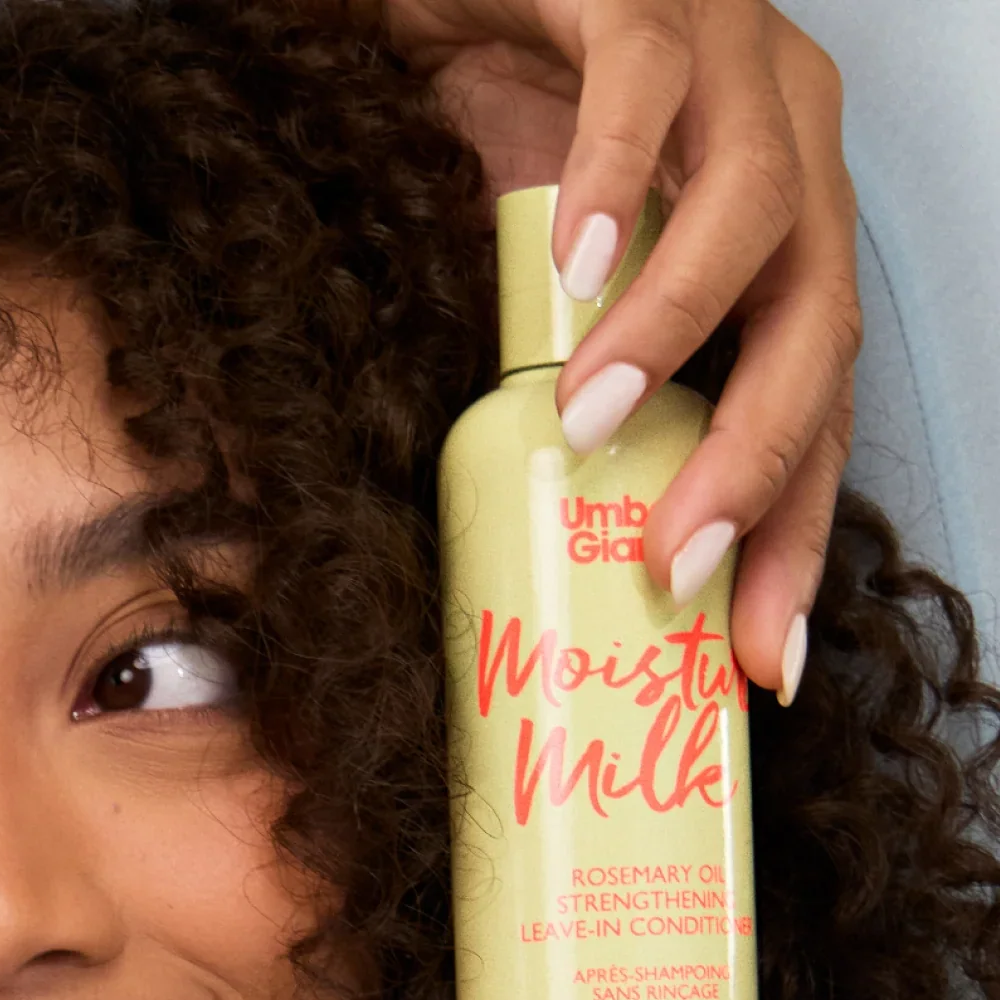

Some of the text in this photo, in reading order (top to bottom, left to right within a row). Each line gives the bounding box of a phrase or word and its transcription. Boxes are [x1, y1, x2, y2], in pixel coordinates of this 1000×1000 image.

[559, 494, 658, 530] Umb
[566, 530, 645, 565] Gia
[477, 609, 750, 718] Moistur
[513, 694, 738, 827] Milk
[571, 864, 726, 888] ROSEMARY OIL
[520, 918, 622, 943] LEAVE-IN
[573, 963, 731, 984] APRÈS-SHAMPOING
